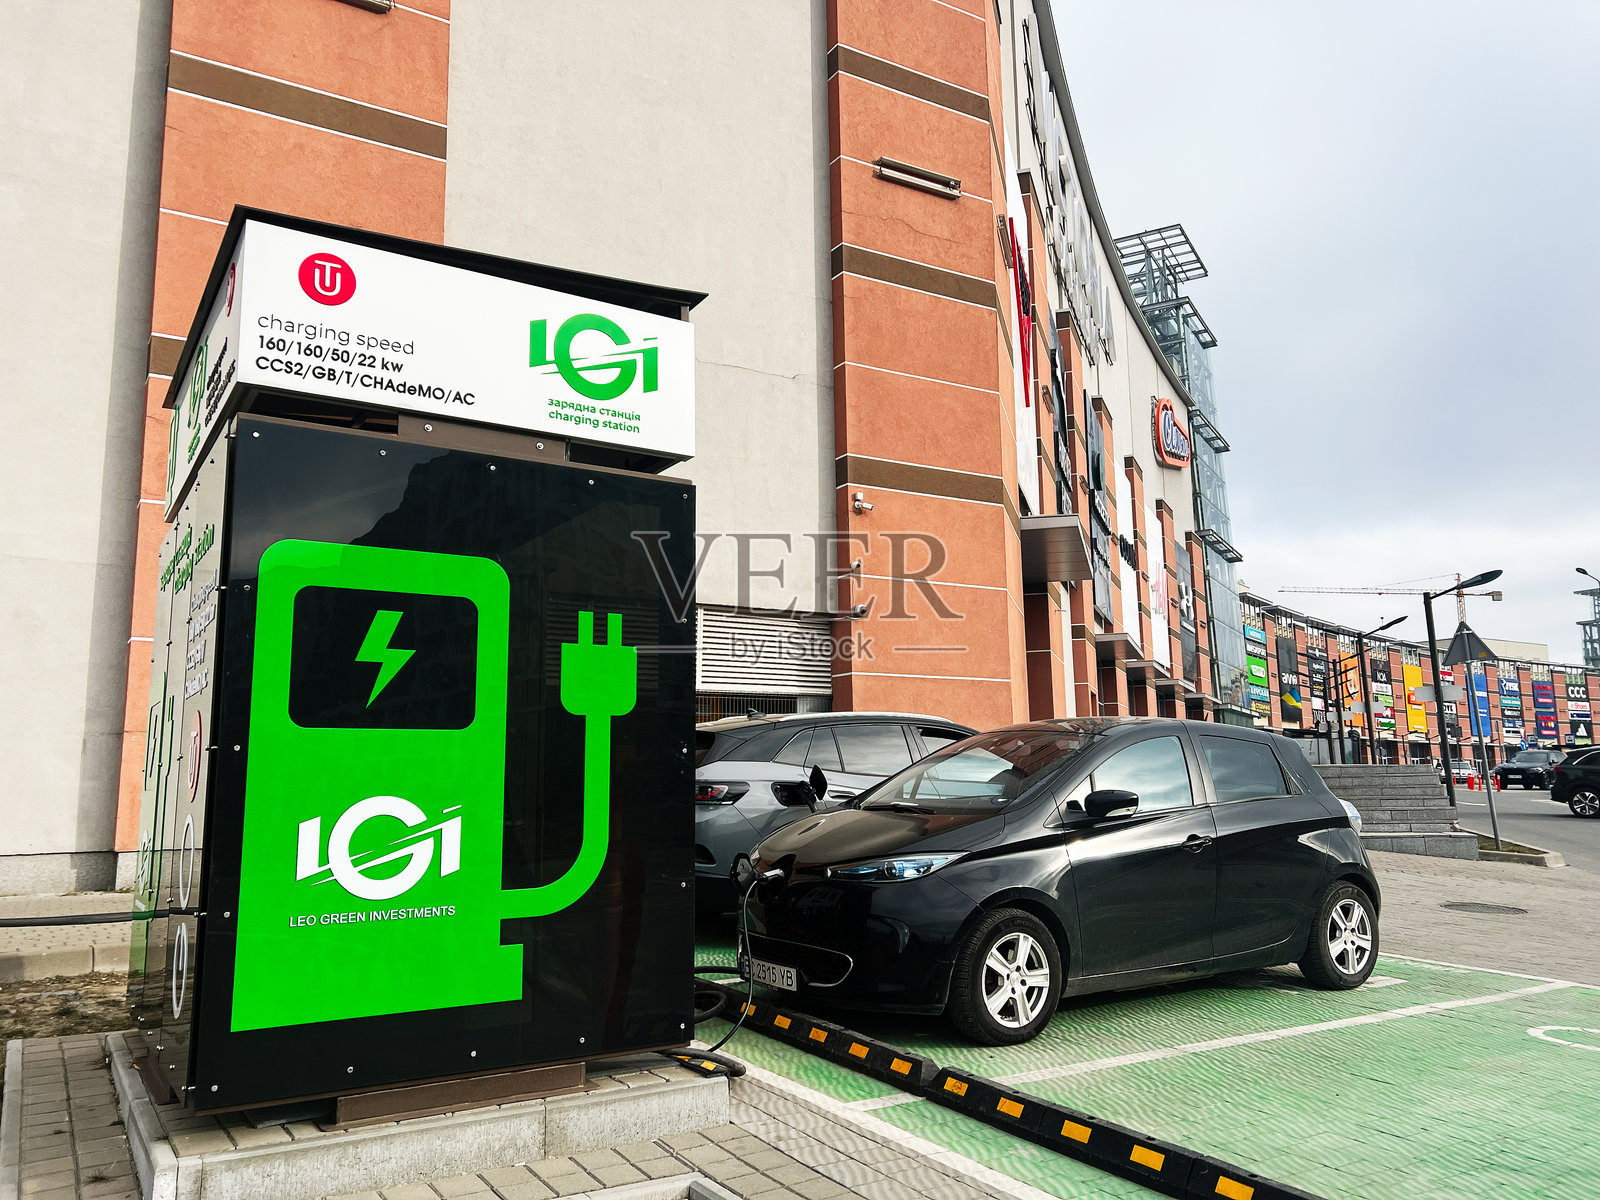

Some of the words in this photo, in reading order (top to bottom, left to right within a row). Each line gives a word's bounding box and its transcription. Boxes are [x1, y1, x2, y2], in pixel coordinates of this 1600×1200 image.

[257, 314, 350, 346] charging
[356, 332, 415, 356] speed
[258, 334, 376, 368] 160/160/50/22
[381, 356, 404, 373] kw
[255, 356, 476, 406] CCS2/GB/T/CHAdeMO/AC
[547, 398, 597, 413] зарядна
[599, 407, 641, 421] станція
[548, 411, 600, 428] charging
[602, 420, 640, 433] station
[1568, 686, 1587, 699] CCC
[289, 915, 317, 928] LEO
[320, 911, 366, 925] GREEN
[369, 905, 456, 922] INVESTMENTS
[757, 962, 777, 984] 2515
[779, 968, 794, 987] YB
